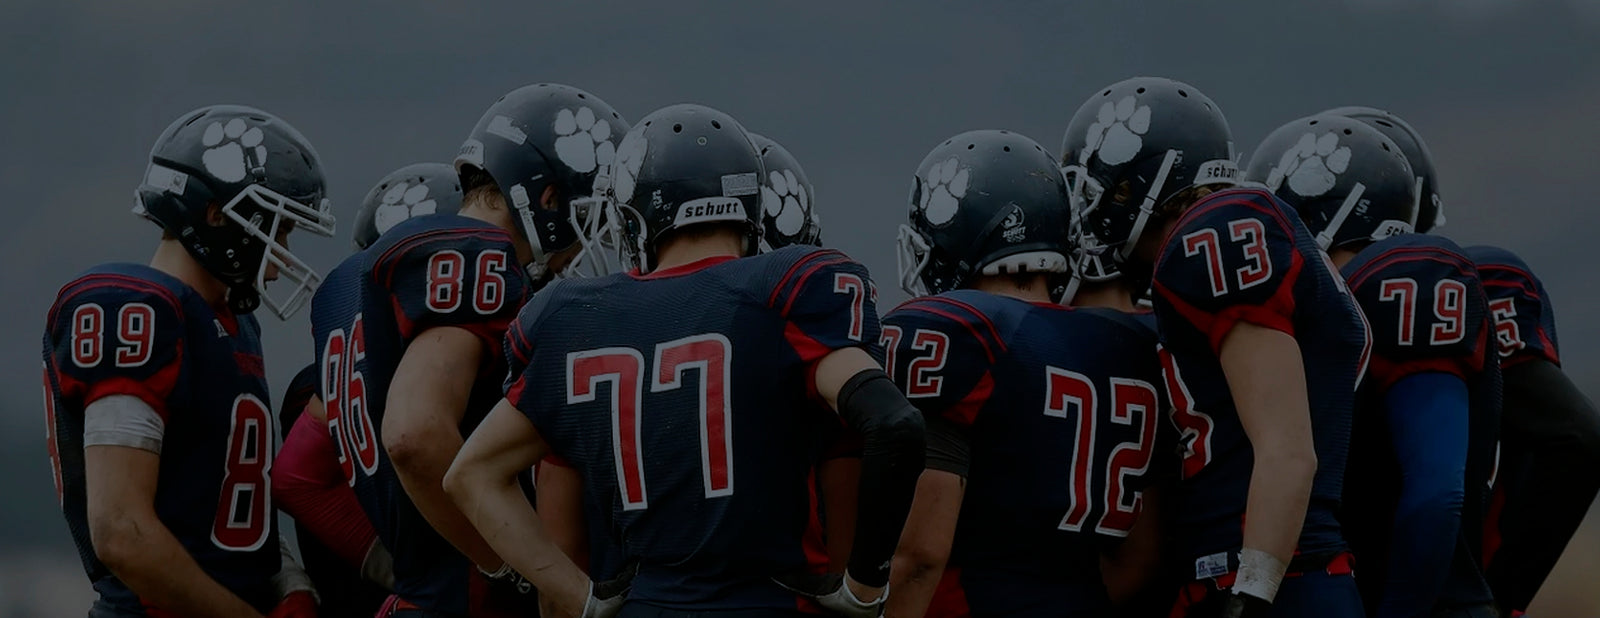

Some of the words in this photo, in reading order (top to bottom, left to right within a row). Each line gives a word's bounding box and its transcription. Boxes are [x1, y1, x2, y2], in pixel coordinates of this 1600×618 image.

[685, 202, 738, 218] schutt
[425, 249, 508, 315] 86
[1183, 217, 1272, 299] 73
[70, 302, 156, 369] 89
[833, 272, 879, 342] 7
[1378, 278, 1467, 347] 79
[878, 324, 950, 399] 72
[321, 312, 379, 487] 86
[566, 332, 735, 512] 77
[210, 392, 272, 552] 8
[1044, 364, 1160, 538] 72
